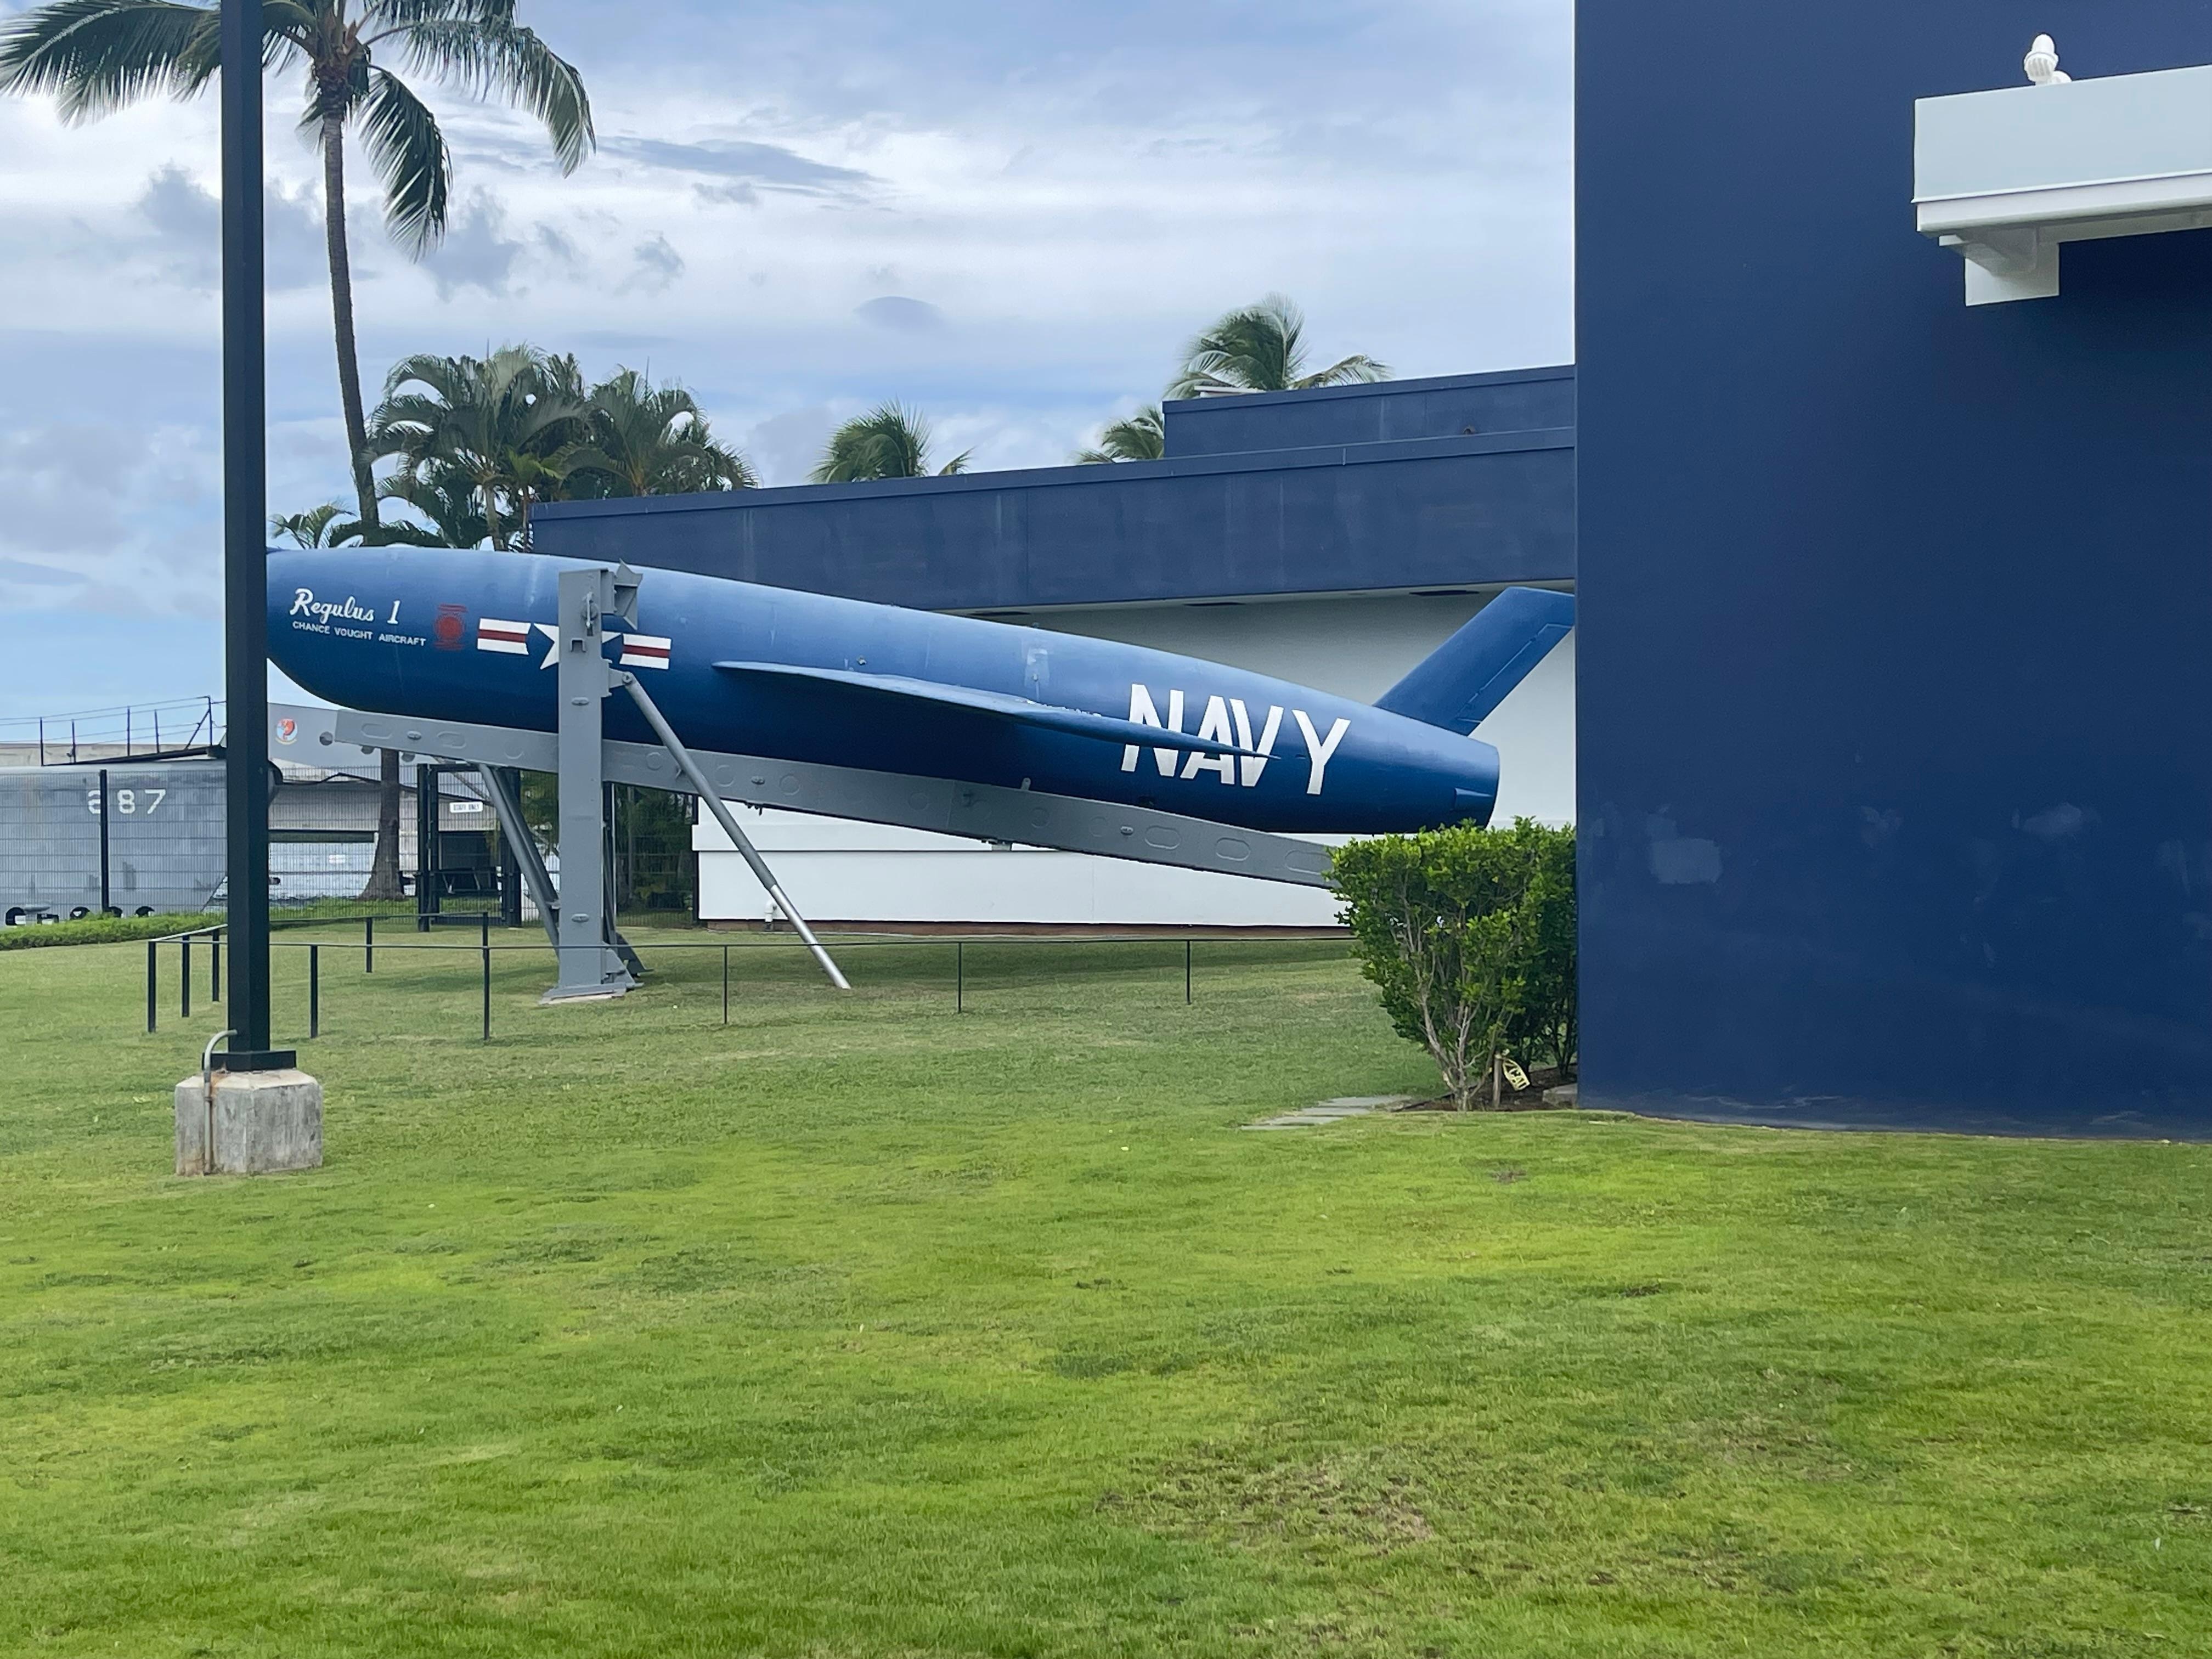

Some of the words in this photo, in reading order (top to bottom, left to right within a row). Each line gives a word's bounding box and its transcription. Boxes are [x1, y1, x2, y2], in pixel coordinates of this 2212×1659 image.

[290, 588, 374, 624] Regulus
[292, 621, 330, 634] CHANCE
[334, 627, 373, 640] VOUGHT
[379, 633, 426, 647] AIRCRAFT
[1121, 683, 1351, 795] NAVY
